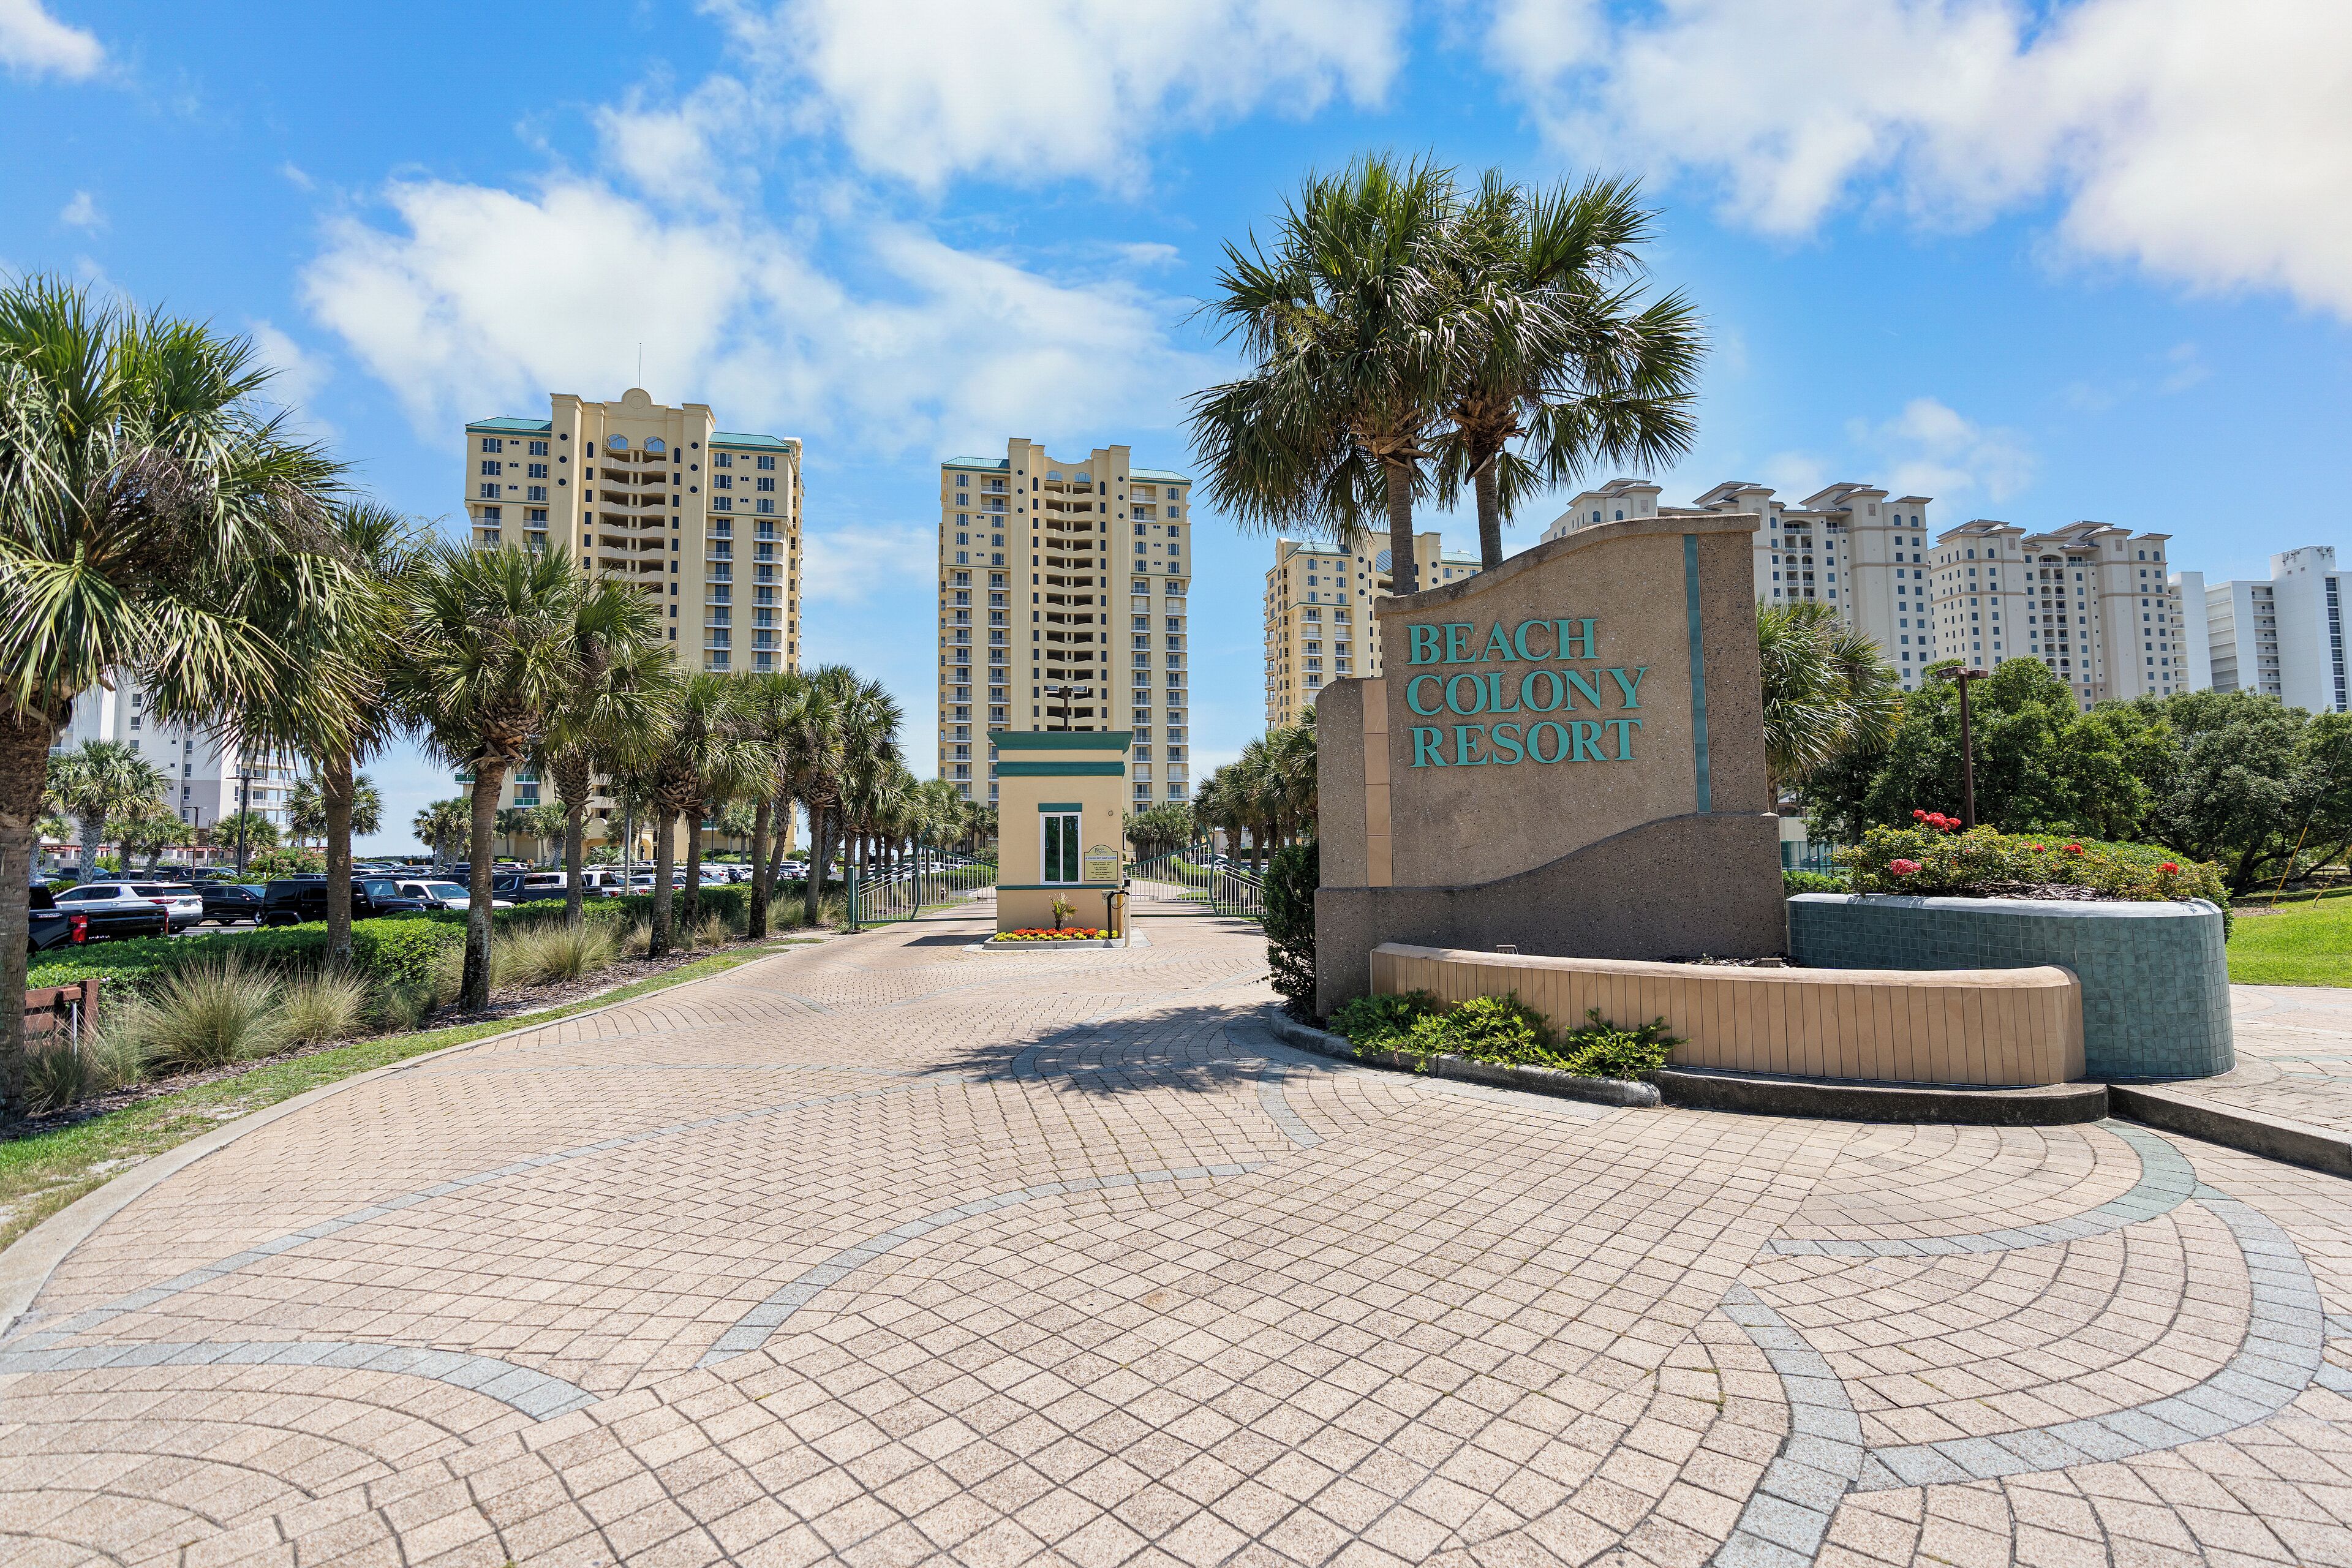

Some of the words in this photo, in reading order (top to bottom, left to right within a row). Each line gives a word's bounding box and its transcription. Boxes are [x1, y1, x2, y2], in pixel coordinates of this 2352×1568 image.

[1406, 618, 1600, 665] BEACH
[1406, 666, 1649, 716] COLONY
[1408, 718, 1643, 768] RESORT
